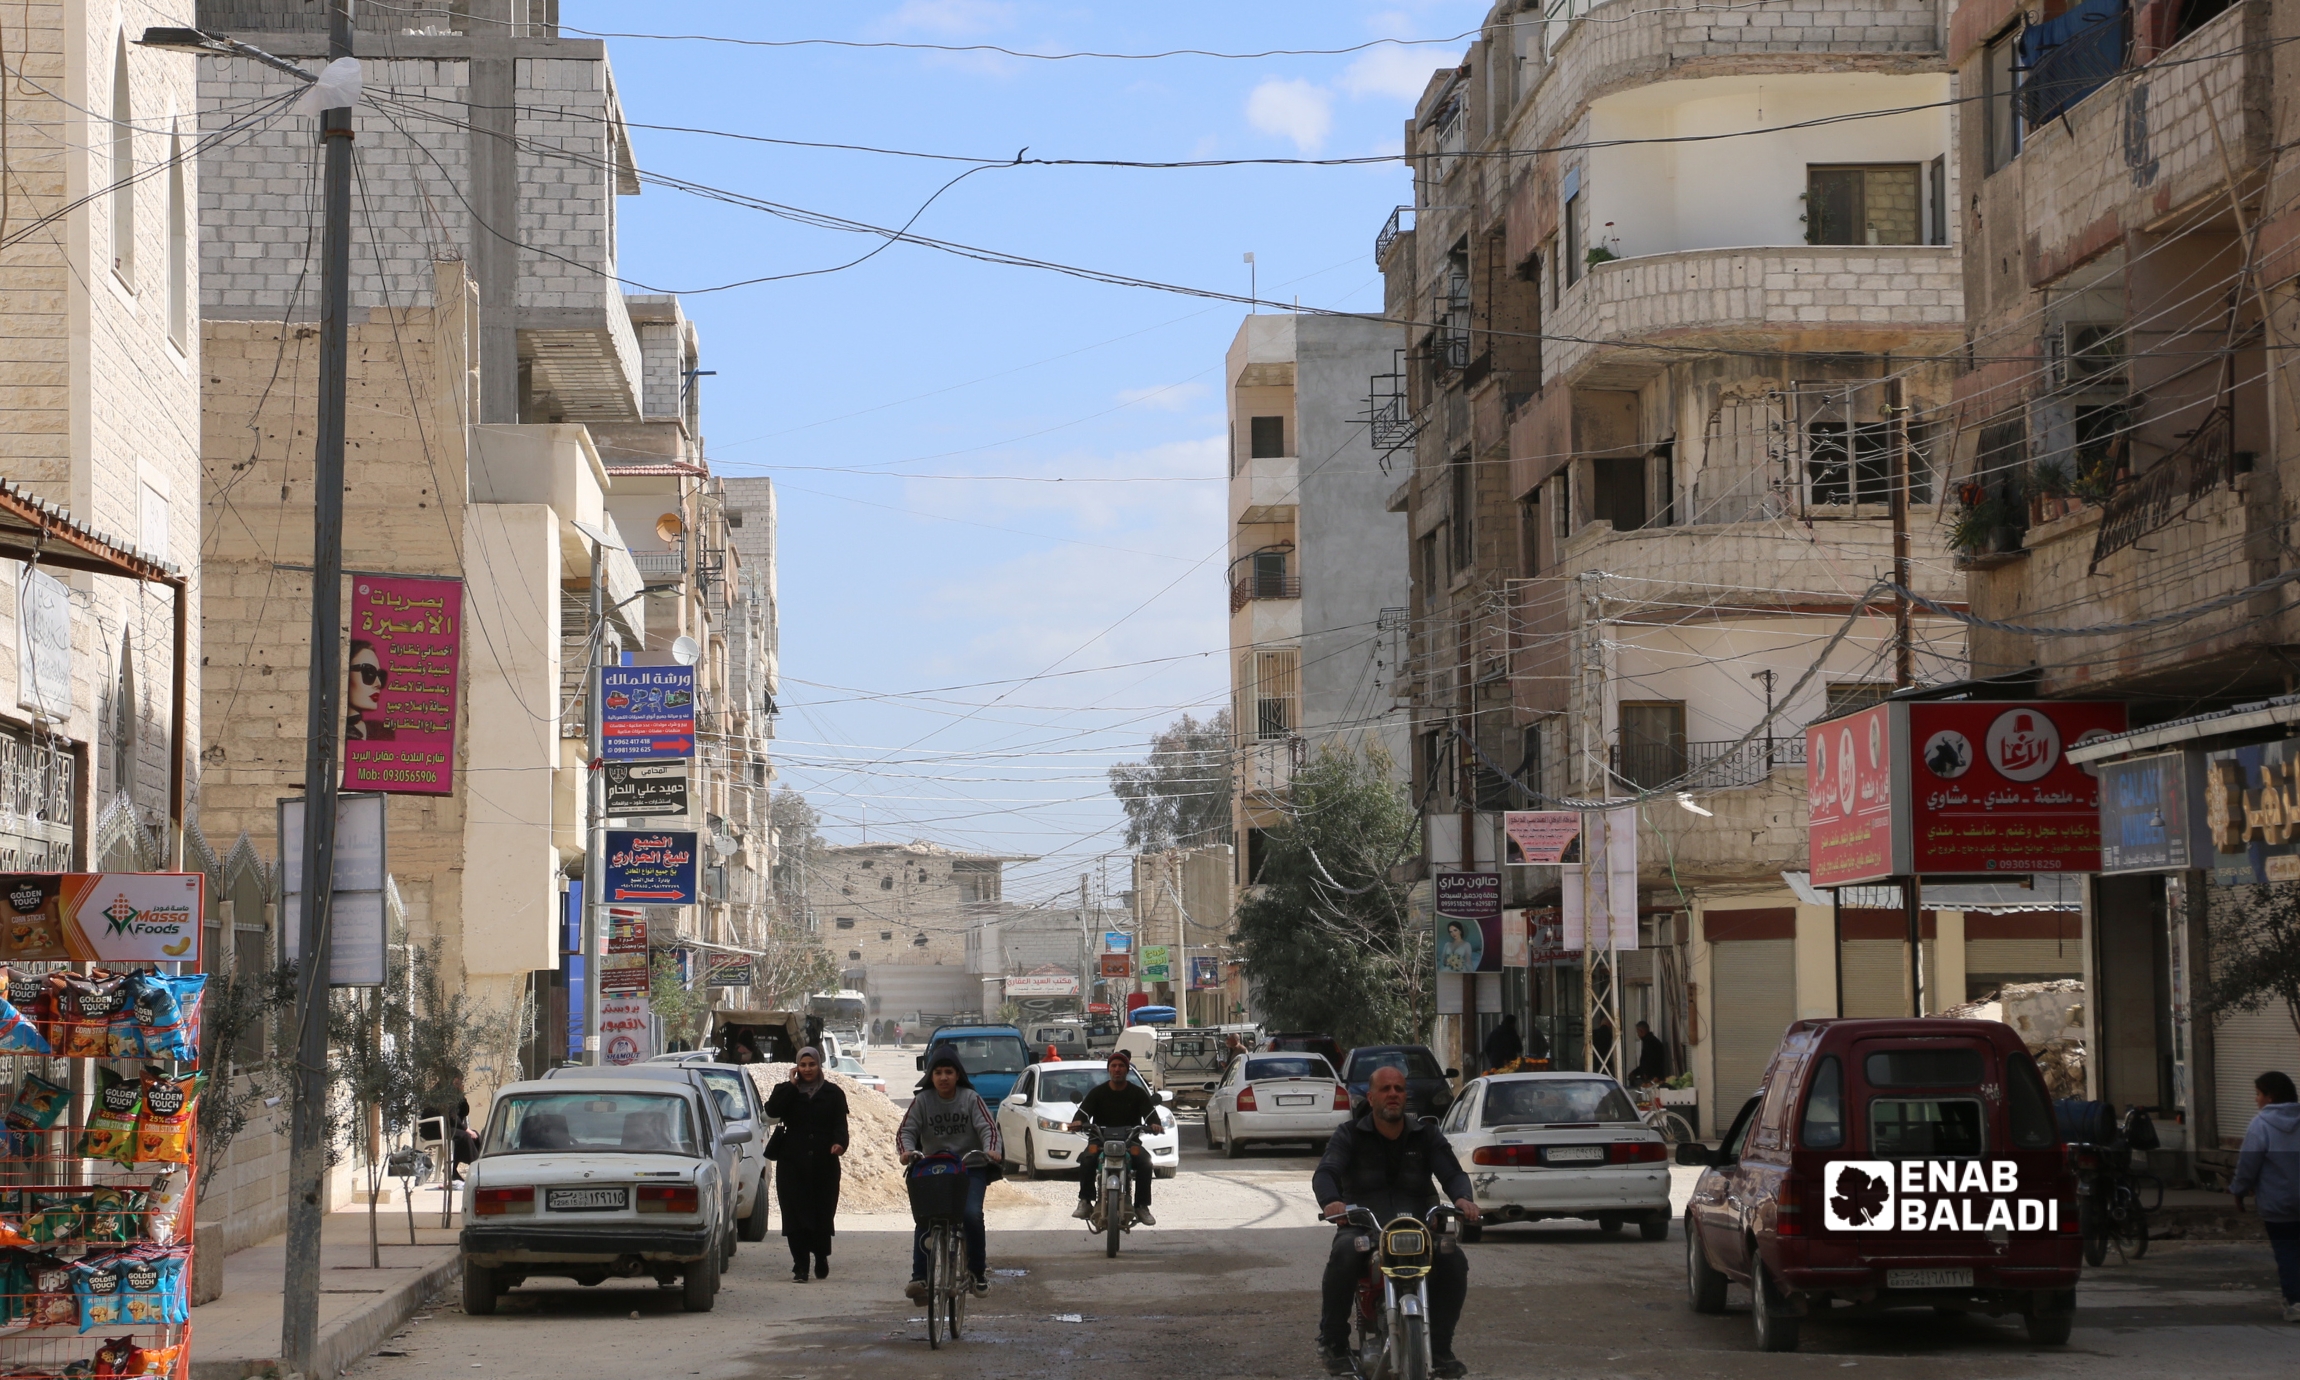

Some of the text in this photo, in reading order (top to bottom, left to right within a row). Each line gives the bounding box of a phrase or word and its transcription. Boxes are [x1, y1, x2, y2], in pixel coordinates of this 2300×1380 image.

[370, 589, 444, 613] بصريات
[361, 610, 452, 640] الأميرة
[389, 643, 420, 656] نظارات
[389, 660, 451, 677] طبية وشمسية
[605, 672, 691, 687] ورشة المالك
[415, 681, 450, 696] وعدسات
[386, 702, 403, 714] جميع
[429, 700, 449, 715] صيانة
[383, 717, 424, 731] النظارات
[351, 750, 445, 766] شارع البلدية مقابل البريد
[358, 768, 437, 783] Mob: 0930565906
[641, 767, 668, 776] المحامي
[608, 783, 684, 799] حميد علي اللحام
[2033, 787, 2073, 806] ملحمة
[1926, 785, 1968, 811] مشاوي
[1984, 788, 2020, 811] مندي
[1926, 825, 1954, 841] مندي
[1962, 823, 1996, 837] مناسف
[2034, 825, 2057, 839] عجل
[2060, 824, 2091, 838] وكباب
[612, 849, 690, 868] للبخ الحراري
[1999, 860, 2062, 869] 0930518250
[1439, 876, 1499, 890] صالون ماري
[10, 889, 42, 900] GOLDEN
[13, 897, 40, 906] TOUCH
[153, 905, 170, 913] فودز
[11, 913, 46, 924] CORN STICKS
[135, 910, 190, 923] Massa
[135, 923, 180, 934] Foods
[9, 981, 41, 990] GOLDEN
[1006, 977, 1072, 987] مكتب السيد العقاري
[10, 989, 37, 998] TOUCH
[79, 996, 112, 1004] GOLDEN
[81, 1003, 109, 1011] TOUCH
[75, 1026, 91, 1034] CORN
[600, 1018, 647, 1033] القصور
[605, 1052, 641, 1060] SHAMOUT
[105, 1088, 137, 1099] GOLDEN
[149, 1091, 183, 1101] GOLDEN
[106, 1096, 132, 1106] TOUCH
[151, 1100, 179, 1108] TOUCH
[101, 1110, 117, 1120] 25%
[149, 1115, 165, 1123] 25%
[928, 1112, 969, 1127] JOUDH
[96, 1119, 131, 1131] CORN STICKS
[145, 1123, 181, 1133] CORN STICKS
[933, 1124, 966, 1136] SPORT
[89, 1275, 117, 1284] GOLDEN
[92, 1281, 116, 1289] TOUCH
[130, 1278, 154, 1286] TOUCH
